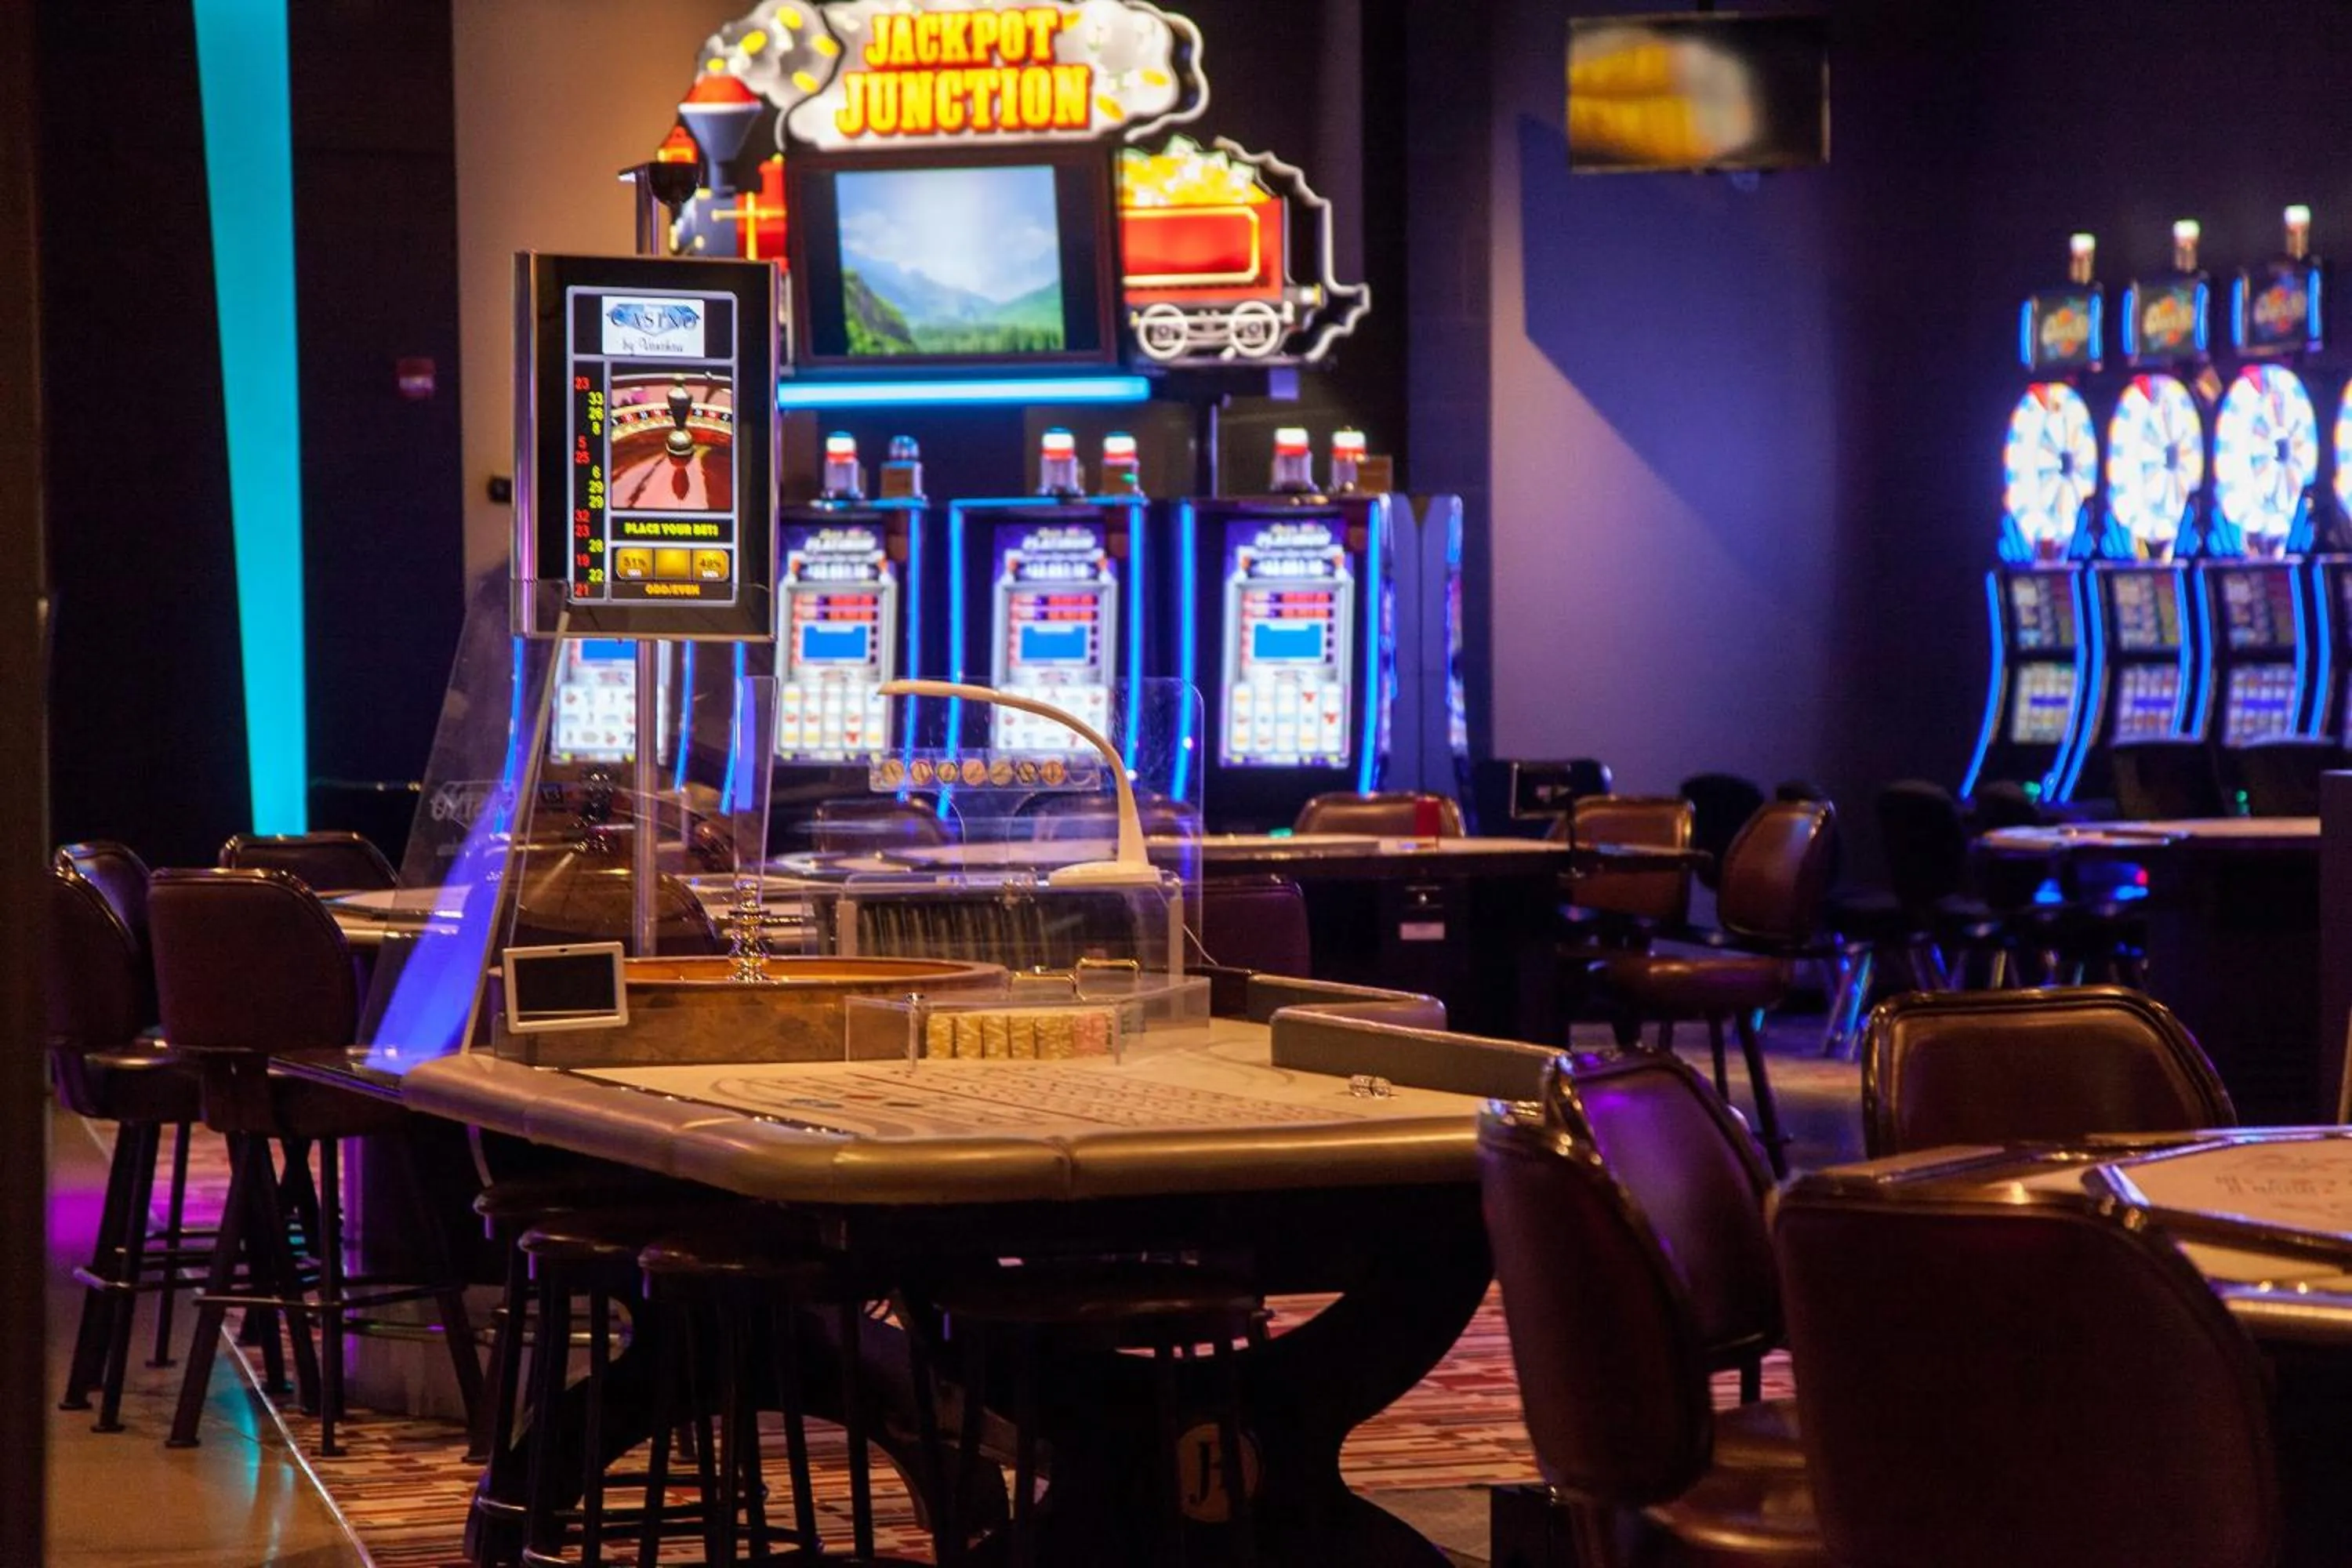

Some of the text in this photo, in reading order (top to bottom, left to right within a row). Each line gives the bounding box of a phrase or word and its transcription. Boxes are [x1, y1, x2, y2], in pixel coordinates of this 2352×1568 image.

[864, 8, 1061, 68] JACKPOT
[834, 63, 1092, 137] JUNCTION
[624, 521, 660, 535] PLACE
[661, 523, 691, 535] YOUR
[645, 583, 700, 596] ODD/EVEN
